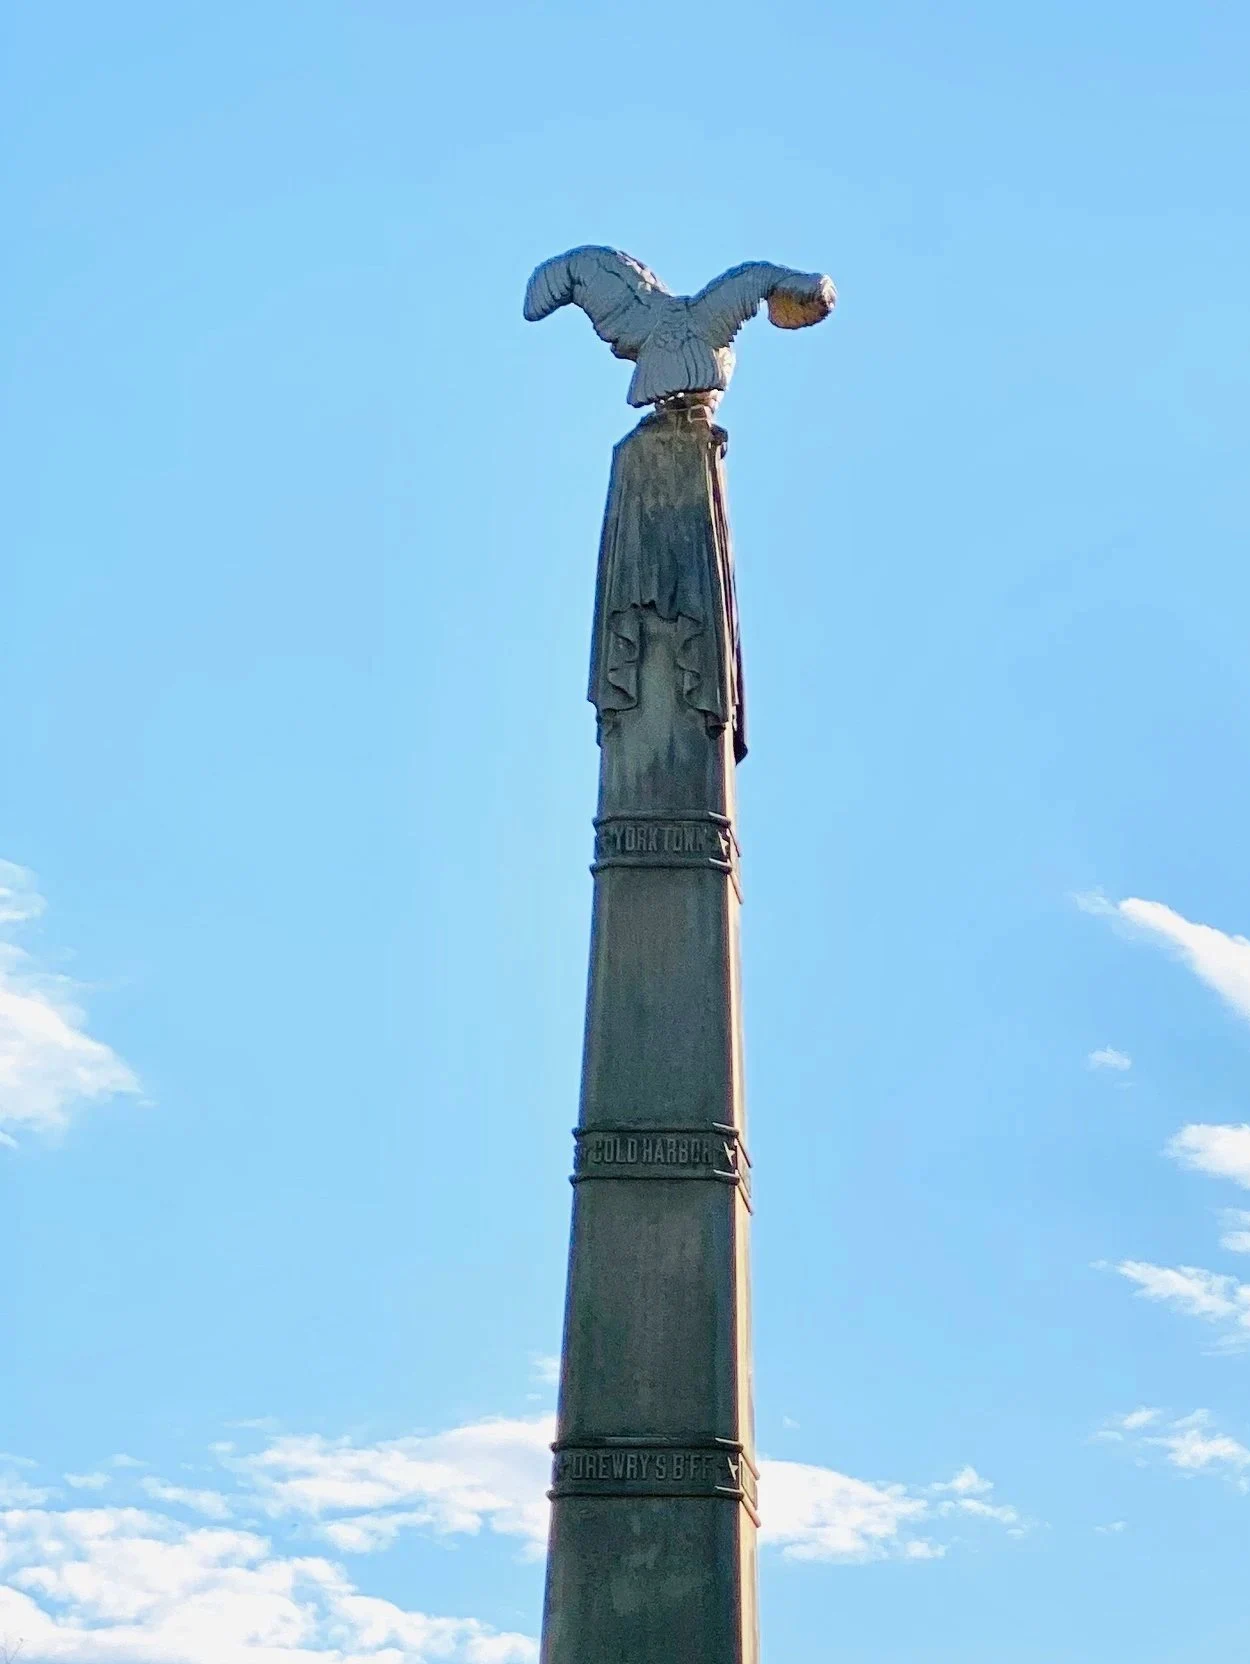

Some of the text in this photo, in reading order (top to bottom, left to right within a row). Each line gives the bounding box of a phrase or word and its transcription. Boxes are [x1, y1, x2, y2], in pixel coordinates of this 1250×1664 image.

[614, 825, 708, 852] YORKTOWN
[592, 1138, 713, 1164] COLD HARBOR
[571, 1453, 667, 1481] DREWRY'S
